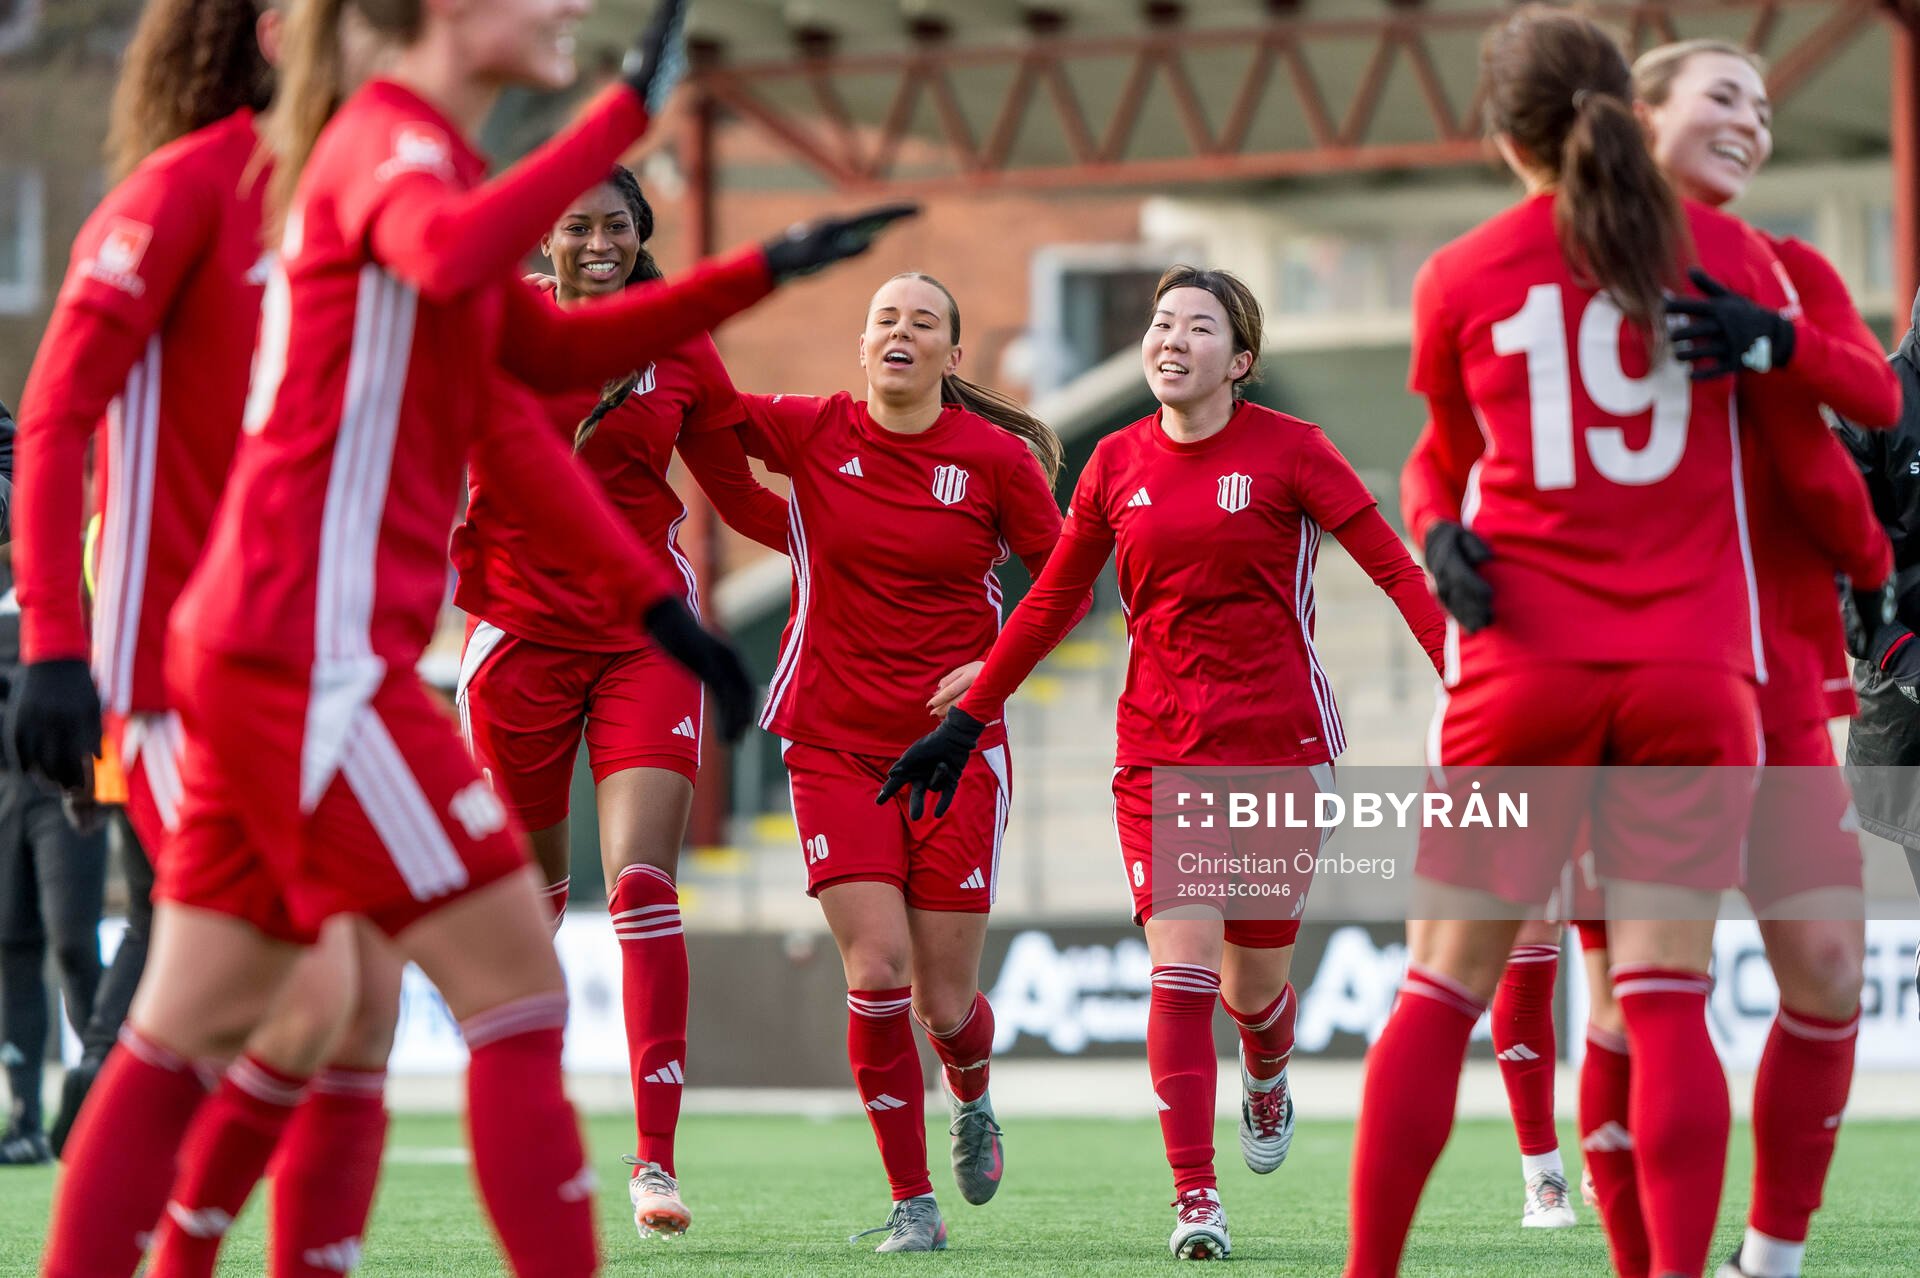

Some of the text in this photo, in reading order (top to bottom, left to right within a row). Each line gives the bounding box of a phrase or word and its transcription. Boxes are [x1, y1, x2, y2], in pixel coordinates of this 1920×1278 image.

[1491, 283, 1692, 491] 19
[806, 833, 829, 865] 20
[1132, 860, 1145, 888] 8
